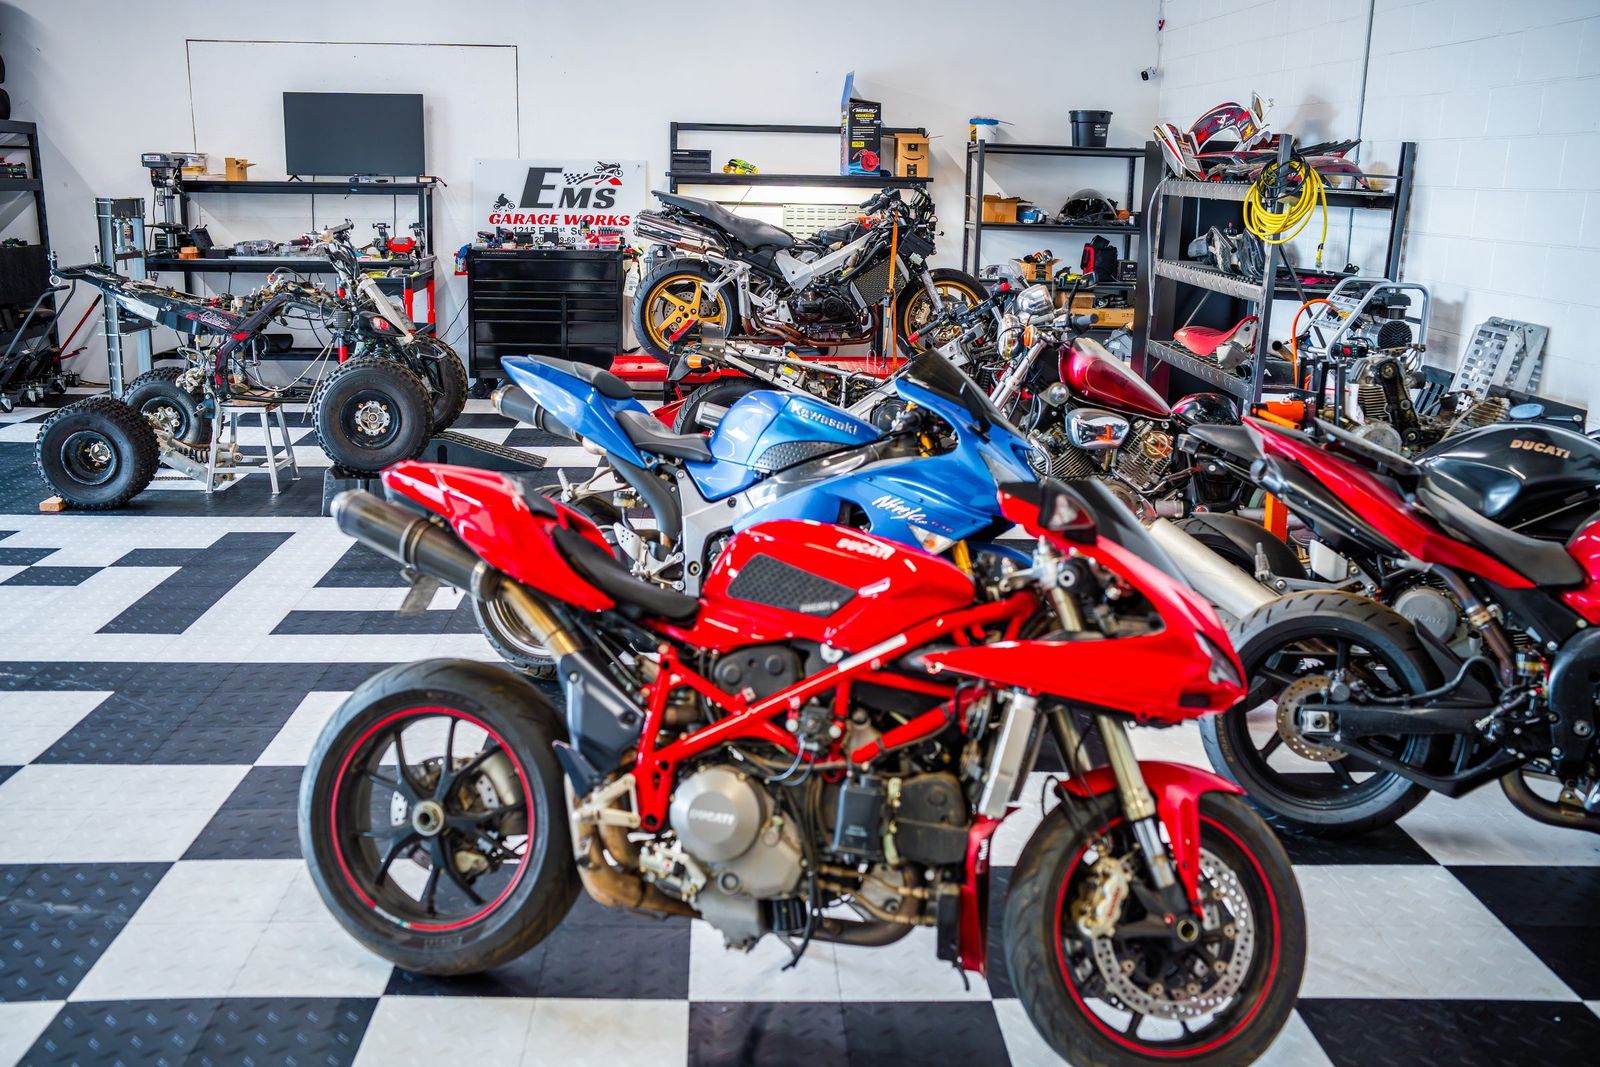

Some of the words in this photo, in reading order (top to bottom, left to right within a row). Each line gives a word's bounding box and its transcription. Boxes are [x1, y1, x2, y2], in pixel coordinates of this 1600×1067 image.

[519, 167, 616, 209] EMS
[488, 213, 560, 225] GARAGE
[564, 214, 630, 226] WORKS
[790, 400, 859, 435] Kawasaki
[1510, 439, 1571, 459] DUCATI
[871, 495, 926, 521] Ninja
[836, 538, 892, 560] DUCATI
[689, 809, 735, 825] DUCATI
